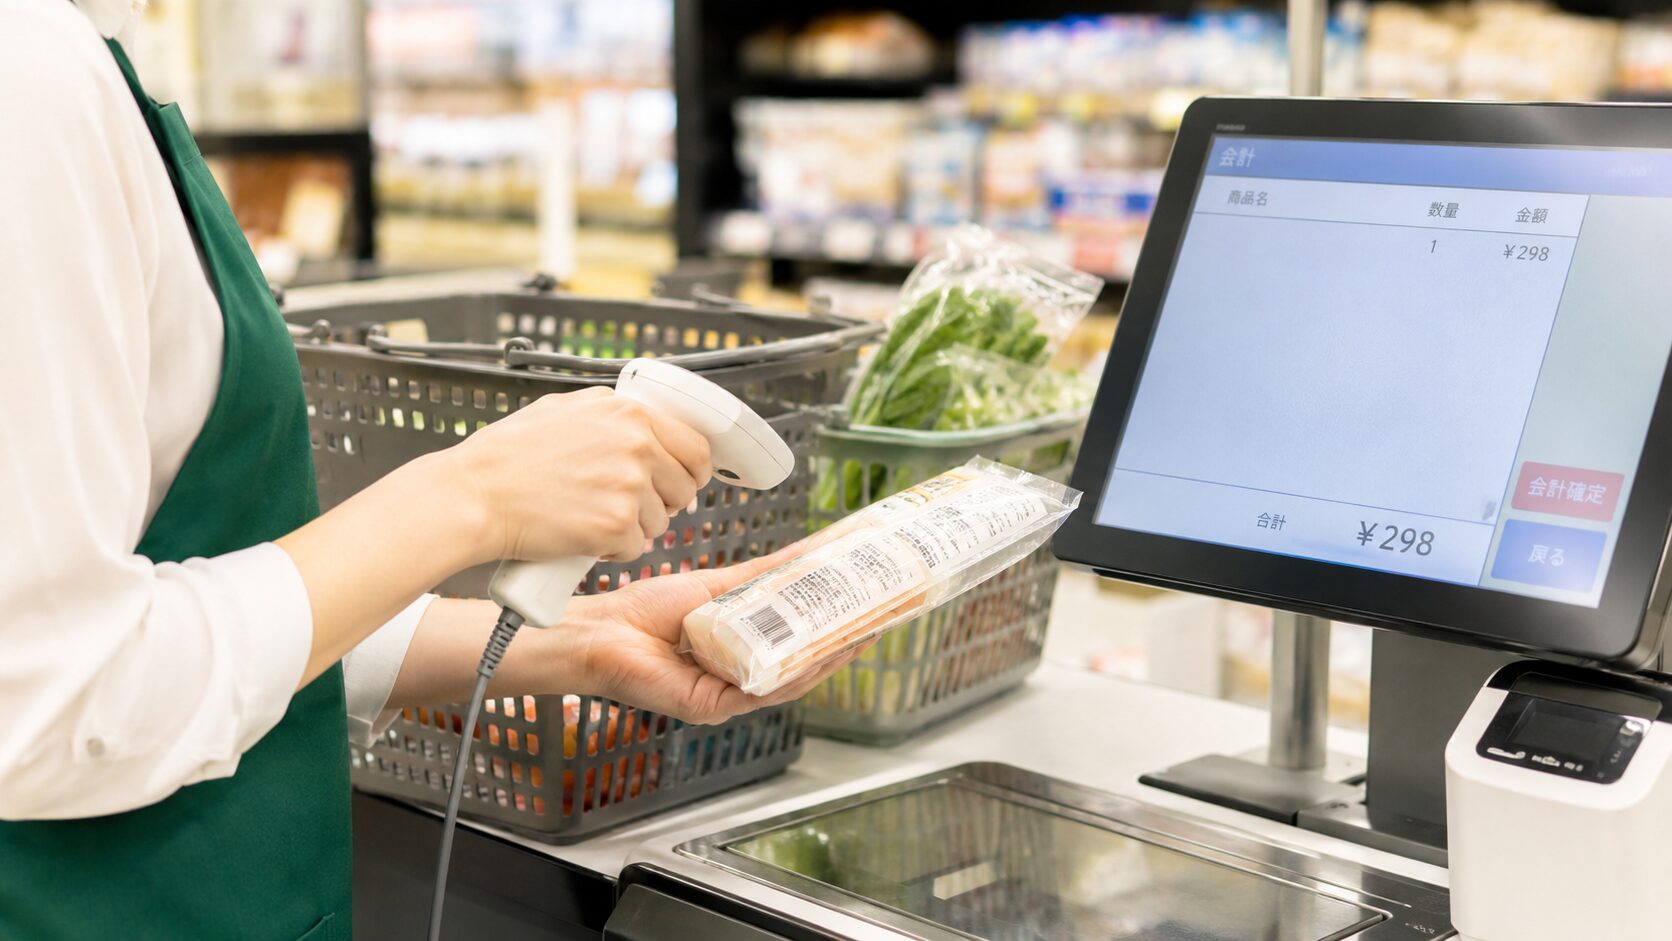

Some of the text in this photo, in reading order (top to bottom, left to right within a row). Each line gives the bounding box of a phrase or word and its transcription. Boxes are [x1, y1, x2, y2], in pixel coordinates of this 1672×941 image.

[1219, 146, 1256, 167] 会計
[1228, 190, 1268, 206] 商品名
[1428, 201, 1459, 218] 数量
[1515, 207, 1549, 223] 金額
[1430, 240, 1437, 254] 1
[1503, 244, 1550, 261] ¥298
[1528, 476, 1607, 504] 会計確定
[1256, 512, 1287, 531] 合計
[1356, 521, 1435, 556] ¥298
[1528, 544, 1565, 567] 戻る
